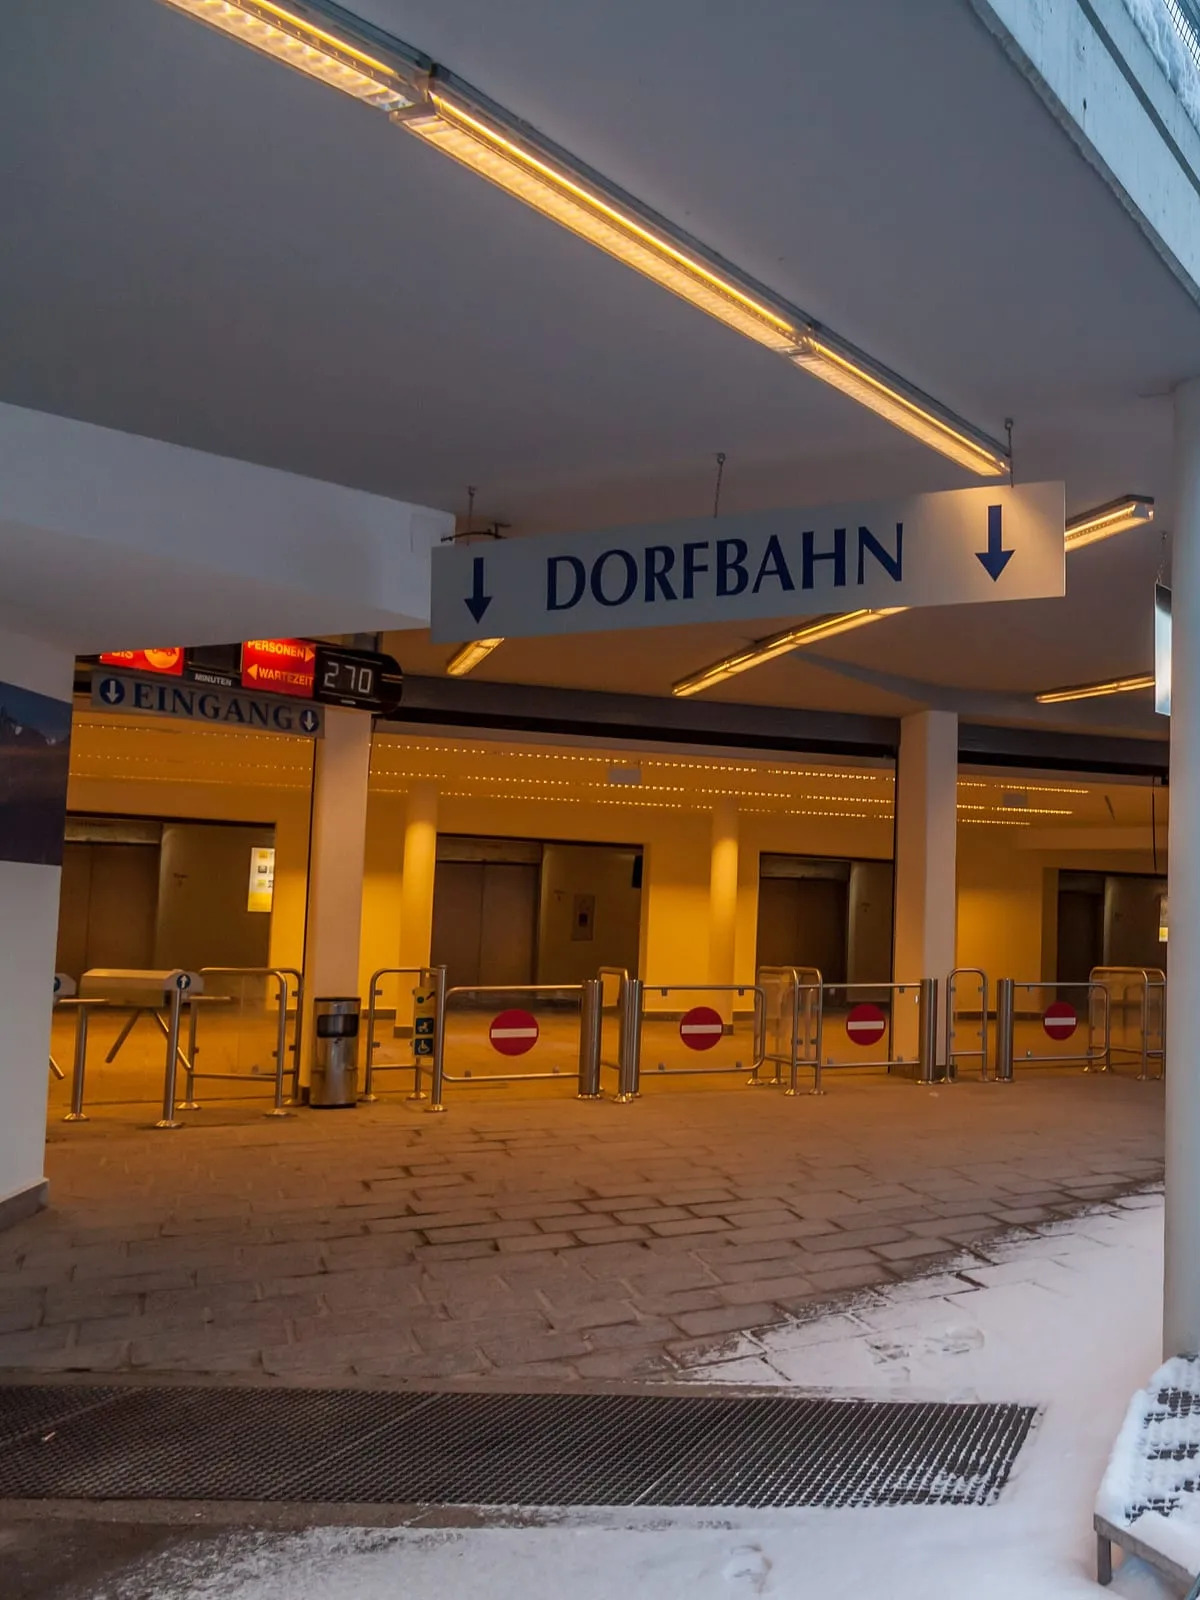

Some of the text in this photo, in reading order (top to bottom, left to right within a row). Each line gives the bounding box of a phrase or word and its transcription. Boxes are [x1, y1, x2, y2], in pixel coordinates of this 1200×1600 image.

[546, 522, 904, 611] DORFBAHN
[247, 640, 306, 658] PERSONEN
[194, 672, 232, 687] MINUTEN
[258, 667, 315, 687] WARTEZEIT
[323, 661, 373, 693] 270
[132, 682, 294, 730] EINGANG
